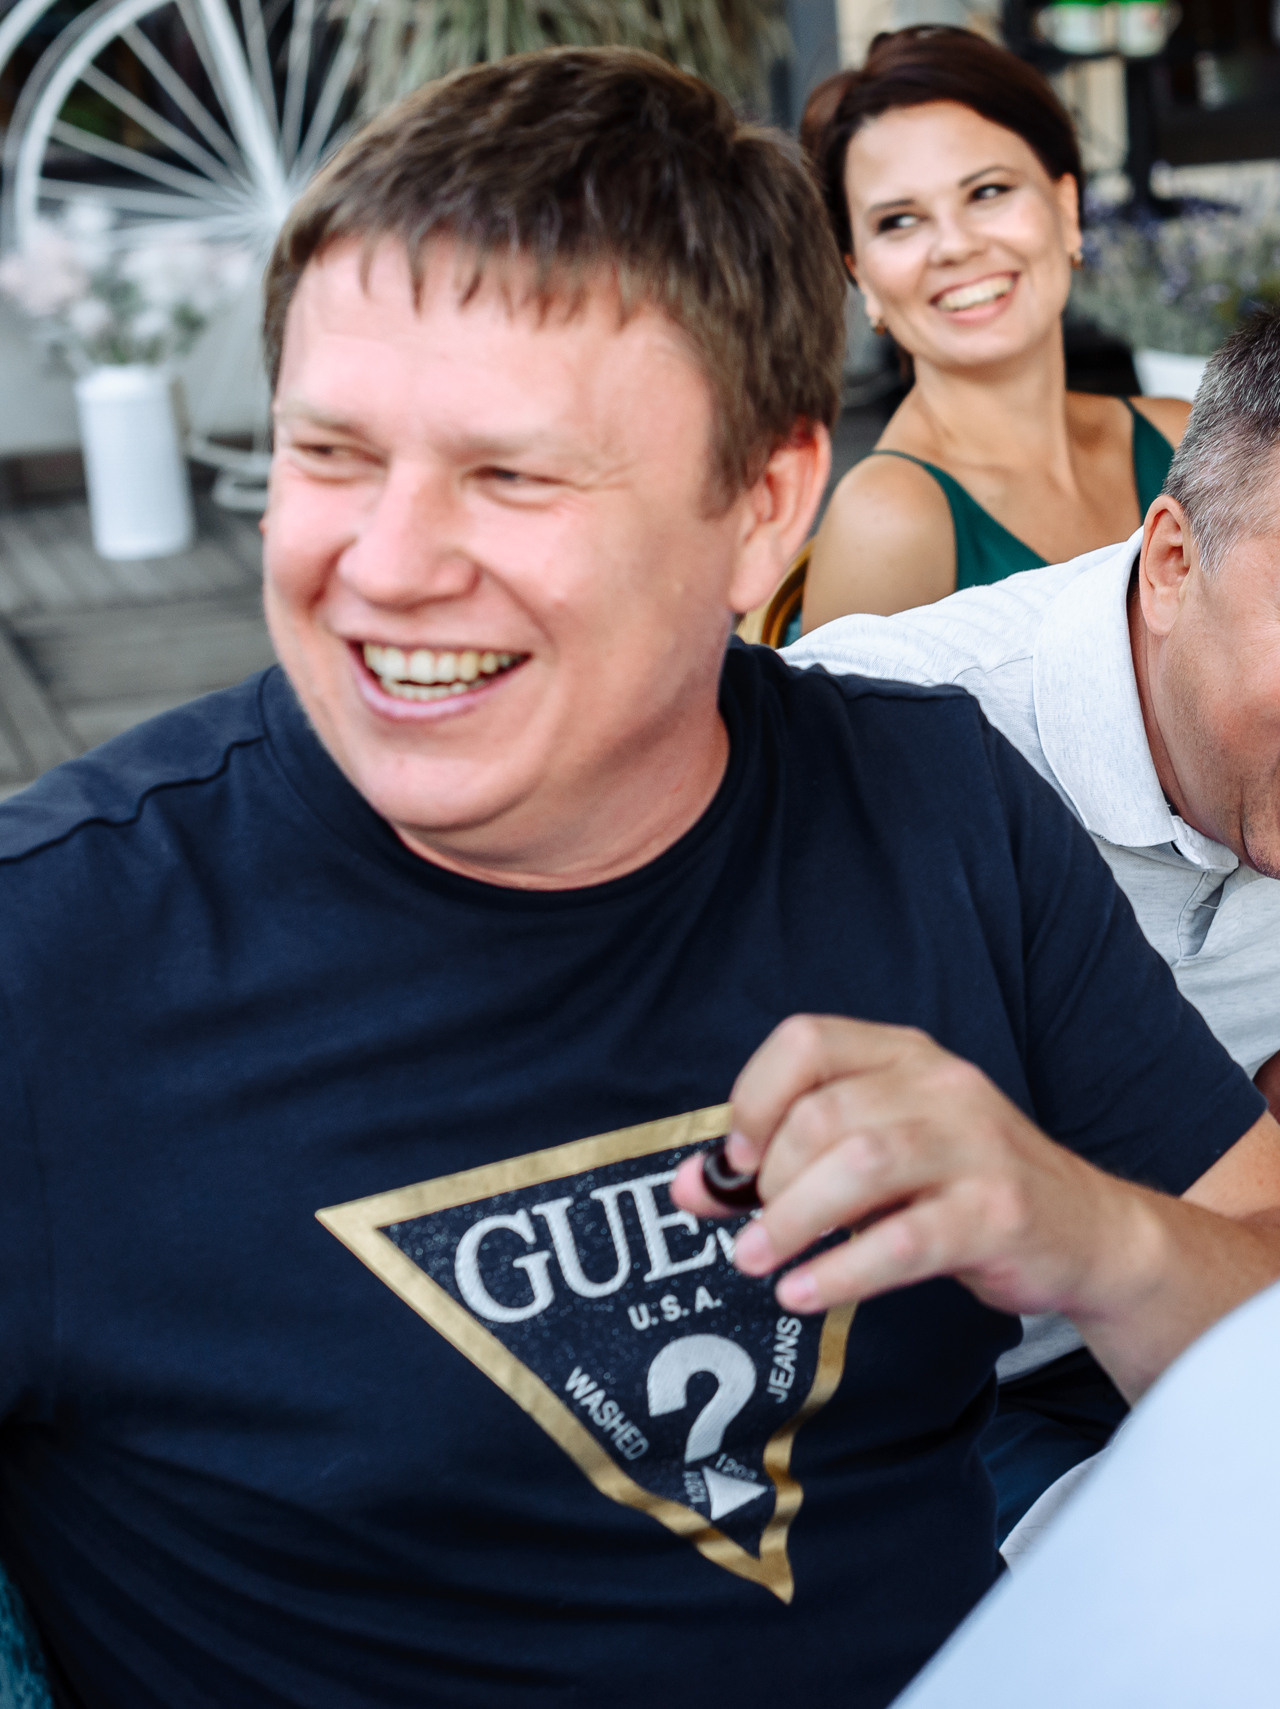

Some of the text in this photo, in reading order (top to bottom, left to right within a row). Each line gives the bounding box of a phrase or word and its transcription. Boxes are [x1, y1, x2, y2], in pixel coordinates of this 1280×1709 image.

[454, 1170, 763, 1323] GUE
[766, 1316, 802, 1404] JEANS
[565, 1365, 649, 1461] WASHED
